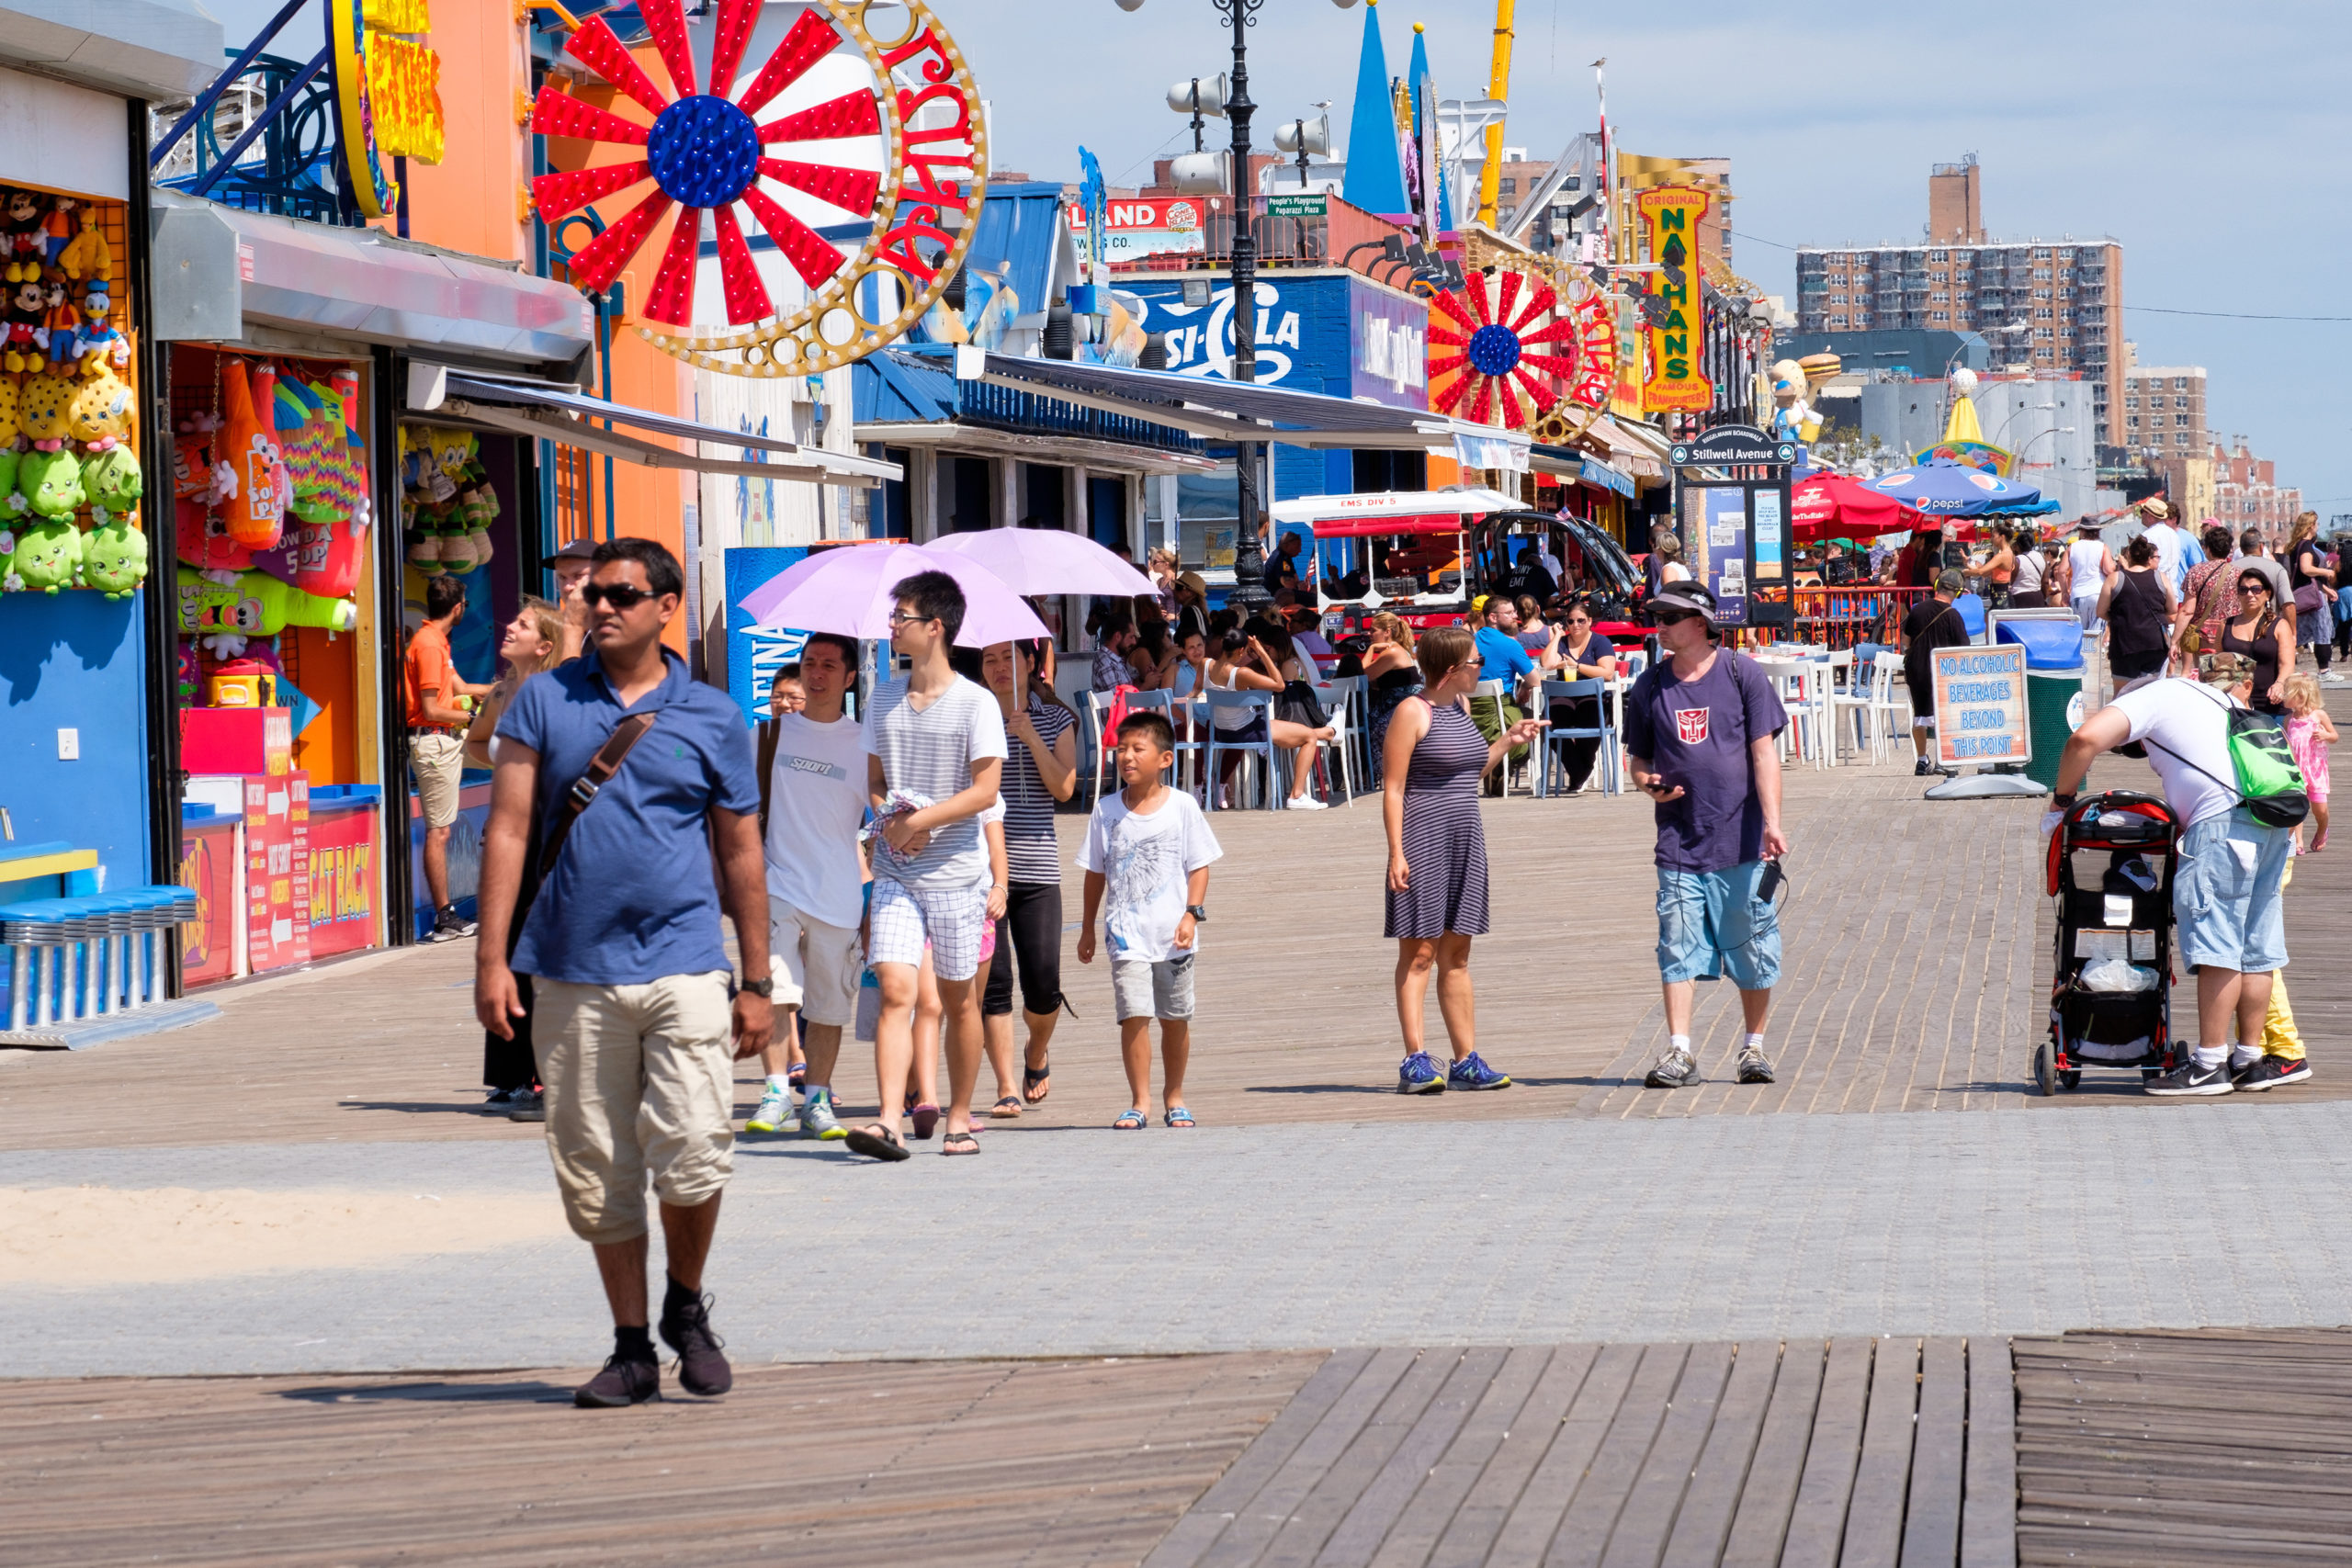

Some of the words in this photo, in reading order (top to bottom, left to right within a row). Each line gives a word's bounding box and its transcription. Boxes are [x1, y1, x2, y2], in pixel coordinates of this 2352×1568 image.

[1269, 197, 1293, 206] People's
[1294, 197, 1325, 206] Playground
[1645, 195, 1701, 206] ORIGINAL
[1167, 207, 1194, 220] CONEY
[1275, 206, 1302, 215] Paparazzi
[1169, 214, 1195, 228] ISLAND
[1113, 237, 1131, 248] CO.
[1661, 209, 1689, 378] NAHANS
[1648, 390, 1706, 404] FRANKFURTERS
[1702, 430, 1733, 444] RIEGELMANN
[1733, 430, 1763, 444] BOARDWALK
[1692, 448, 1734, 460] Stillwell
[1736, 449, 1773, 459] Avenue
[1932, 499, 1963, 510] pepsi
[300, 546, 327, 564] OP
[1939, 657, 1958, 677] NO
[1959, 653, 2020, 675] ALCOHOLIC
[1948, 681, 2011, 704] BEVERAGES
[1960, 708, 2006, 730] BEYOND
[1951, 736, 1978, 758] THIS
[1980, 735, 2012, 756] POINT
[789, 755, 834, 775] sport
[310, 847, 334, 929] CAT
[336, 842, 369, 923] RACK
